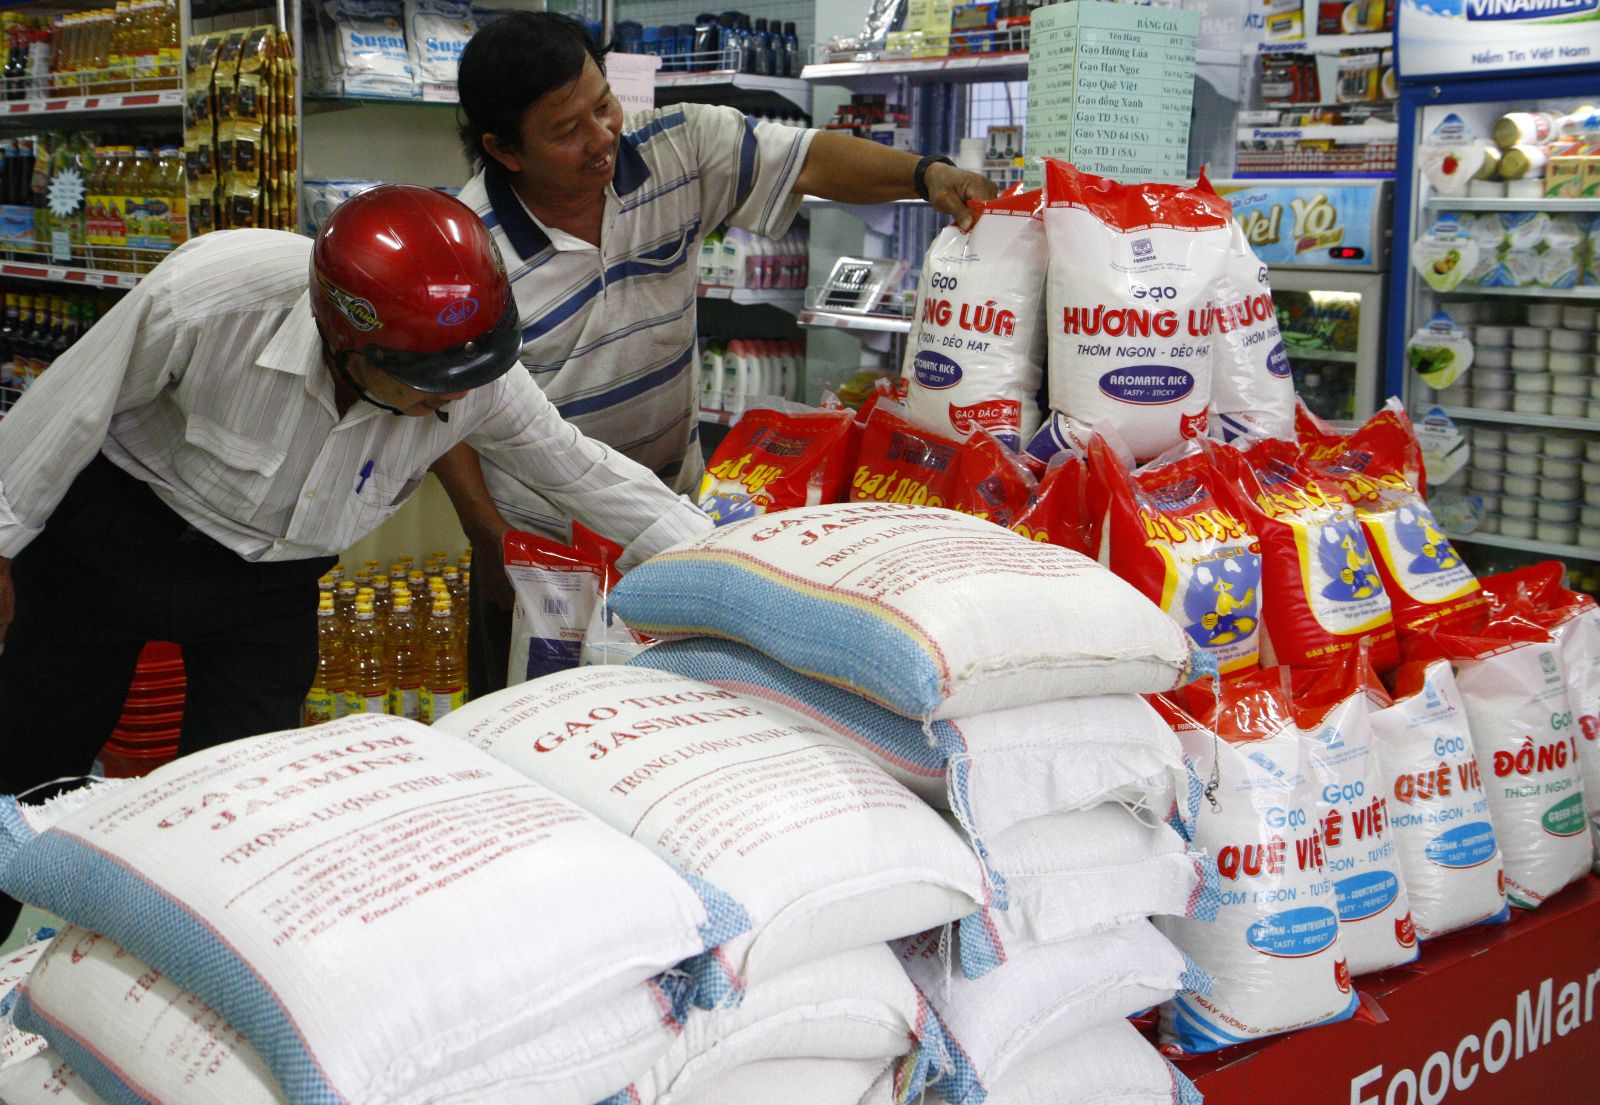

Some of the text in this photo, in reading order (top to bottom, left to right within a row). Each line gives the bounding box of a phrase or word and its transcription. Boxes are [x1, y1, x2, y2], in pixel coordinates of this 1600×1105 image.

[1137, 16, 1178, 32] BẢNG GIÁ
[1080, 43, 1099, 57] Gạo
[1258, 42, 1307, 52] Panasonic
[1508, 50, 1525, 62] Tin
[1531, 49, 1554, 62] Việt
[1559, 47, 1590, 58] Nam
[1079, 61, 1098, 73] Gạo
[1119, 63, 1140, 77] Ngọc
[1078, 77, 1138, 92] Gạo Quê Việt
[1077, 94, 1096, 107] Gạo
[1121, 97, 1143, 109] Xanh
[1076, 111, 1095, 124] Gạo
[1098, 113, 1112, 123] TD
[1075, 128, 1094, 141] Gạo
[1096, 129, 1117, 140] VND
[1119, 130, 1129, 140] 64
[1253, 129, 1302, 139] Panasonic
[1074, 145, 1093, 157] Gạo
[1095, 145, 1109, 156] TD
[1095, 162, 1118, 173] Thơm
[1120, 164, 1153, 176] Jasmine
[1289, 192, 1337, 241] Yo
[932, 271, 958, 292] Gạo
[1132, 284, 1177, 304] Gạo
[959, 300, 1016, 338] LÚA
[1063, 304, 1180, 339] HƯƠNG
[1214, 291, 1275, 334] HƯƠN
[967, 340, 991, 353] HẠT
[1242, 329, 1266, 348] THƠM
[1077, 343, 1113, 358] THƠM
[1116, 345, 1156, 358] NGON
[1195, 344, 1211, 359] HẠT
[939, 362, 955, 375] RICE
[1110, 374, 1188, 387] AROMATIC RICE
[1123, 388, 1176, 398] TASTY STICKY
[799, 512, 962, 547] JASMINE
[816, 535, 880, 570] TRỌNG
[533, 688, 742, 753] GẠO THƠM
[589, 705, 764, 761] JASMINE
[278, 736, 416, 773] THƠM
[1434, 736, 1464, 757] Gạo
[1493, 735, 1568, 778] ĐỒNG
[610, 750, 676, 798] TRỌNG
[676, 734, 741, 760] LƯỢNG
[211, 752, 426, 830] JASMINE
[1323, 780, 1364, 804] Gạo
[1394, 762, 1452, 805] QUÊ
[1504, 777, 1573, 799] THƠM NGON
[311, 781, 392, 822] LƯỢNG
[1266, 806, 1306, 831] Gạo
[1352, 795, 1389, 839] VIỆT
[1391, 806, 1463, 828] HƠM NGON
[1217, 834, 1287, 880] QUÊ
[1253, 889, 1297, 904] NGON
[1273, 934, 1329, 948] TASTY PERFECT
[1219, 1012, 1248, 1033] HƯƠNG
[1350, 967, 1600, 1105] FoocoMar
